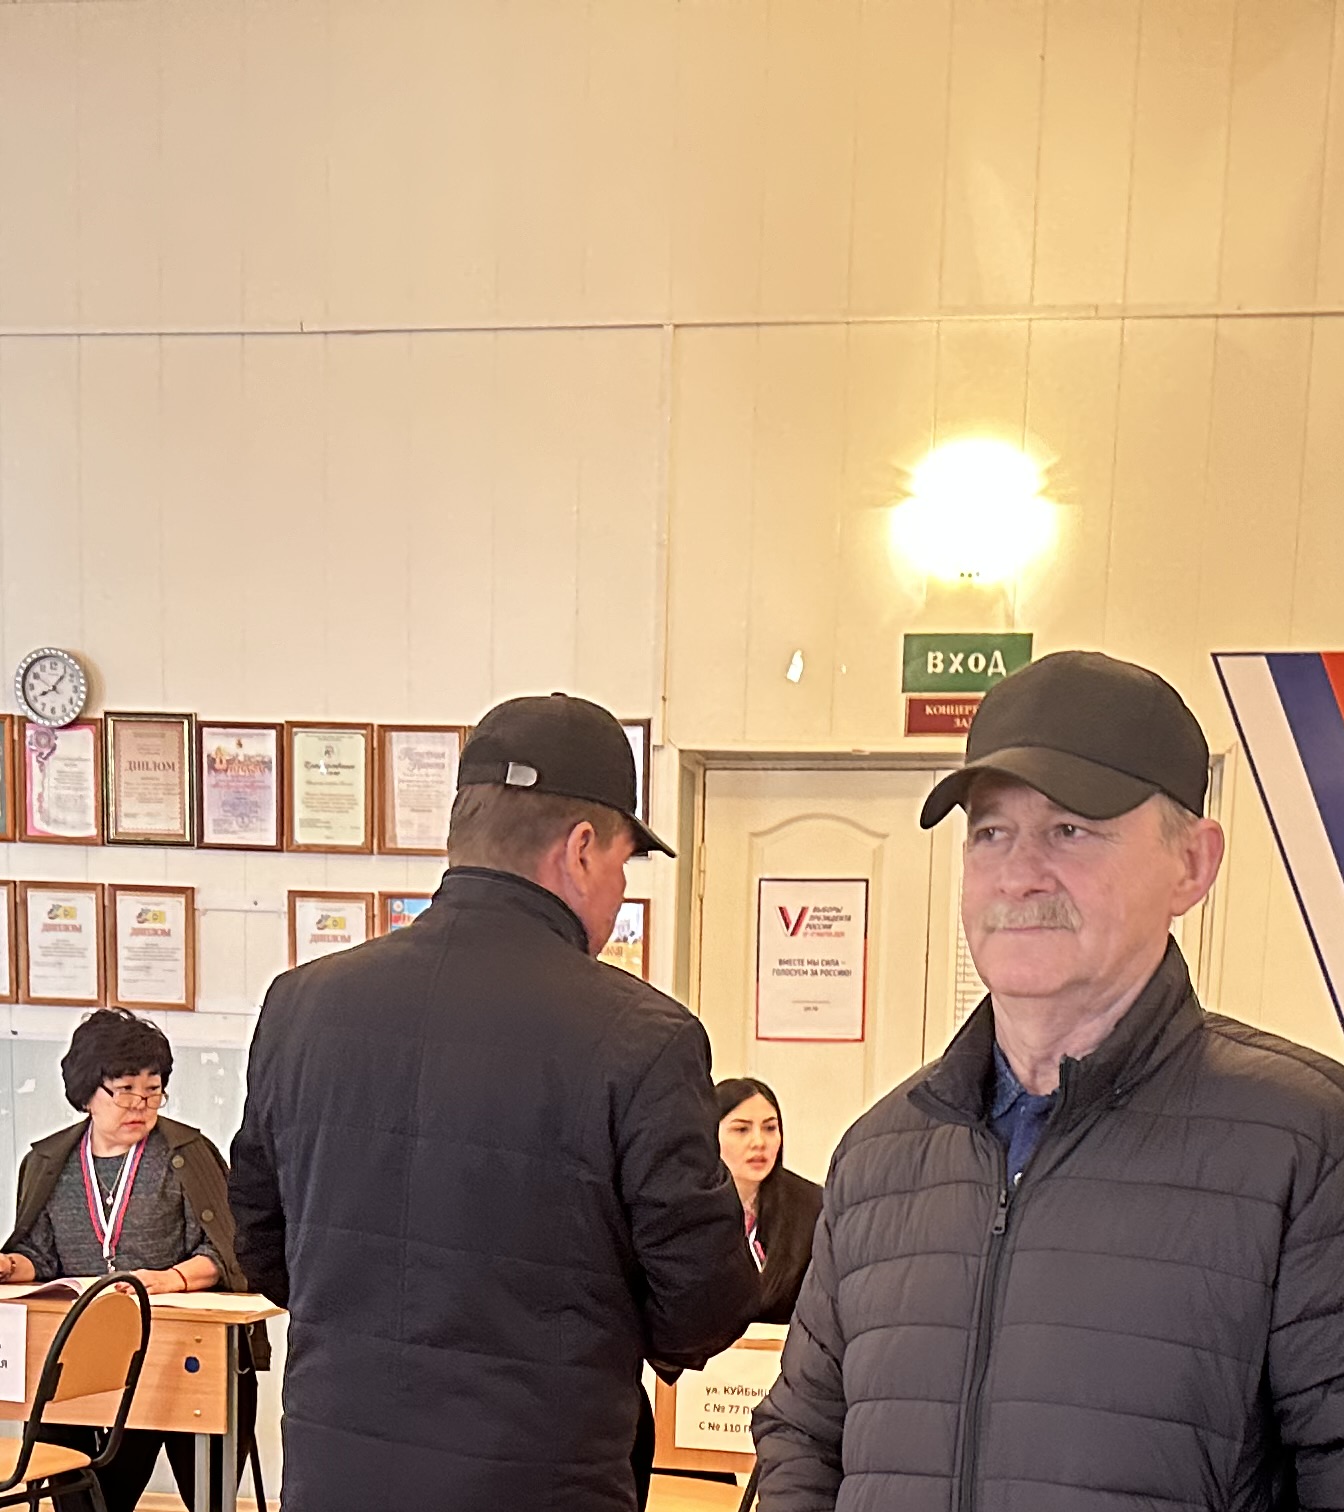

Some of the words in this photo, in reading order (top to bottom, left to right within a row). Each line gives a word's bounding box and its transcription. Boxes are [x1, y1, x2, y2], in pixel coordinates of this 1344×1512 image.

[926, 649, 1008, 678] ВХОД
[778, 958, 805, 967] ВМЕСТЕ
[806, 959, 820, 967] МЫ
[704, 1403, 711, 1412] С
[728, 1404, 740, 1414] 77
[723, 1423, 741, 1432] 110
